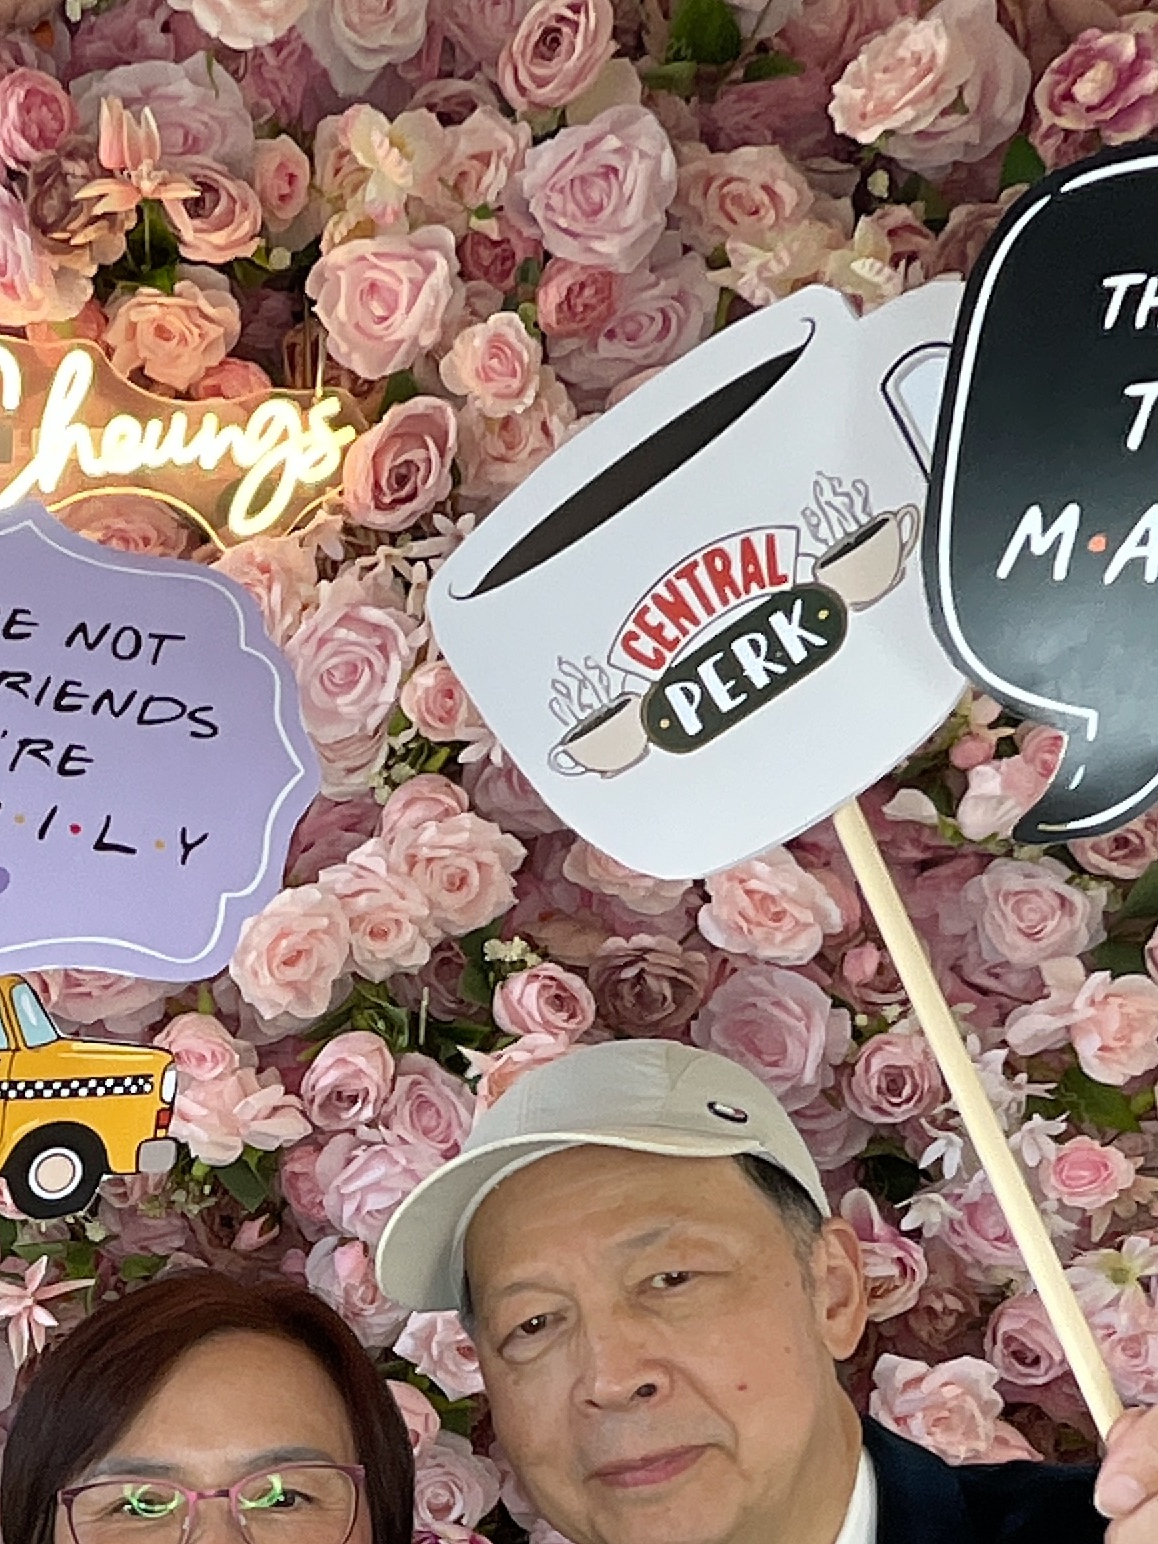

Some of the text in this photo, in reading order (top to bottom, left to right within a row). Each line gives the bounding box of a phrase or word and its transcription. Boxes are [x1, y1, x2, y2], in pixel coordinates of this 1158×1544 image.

[64, 621, 187, 665] NOT
[621, 532, 790, 672] CENTRAL
[664, 598, 829, 736] PERK
